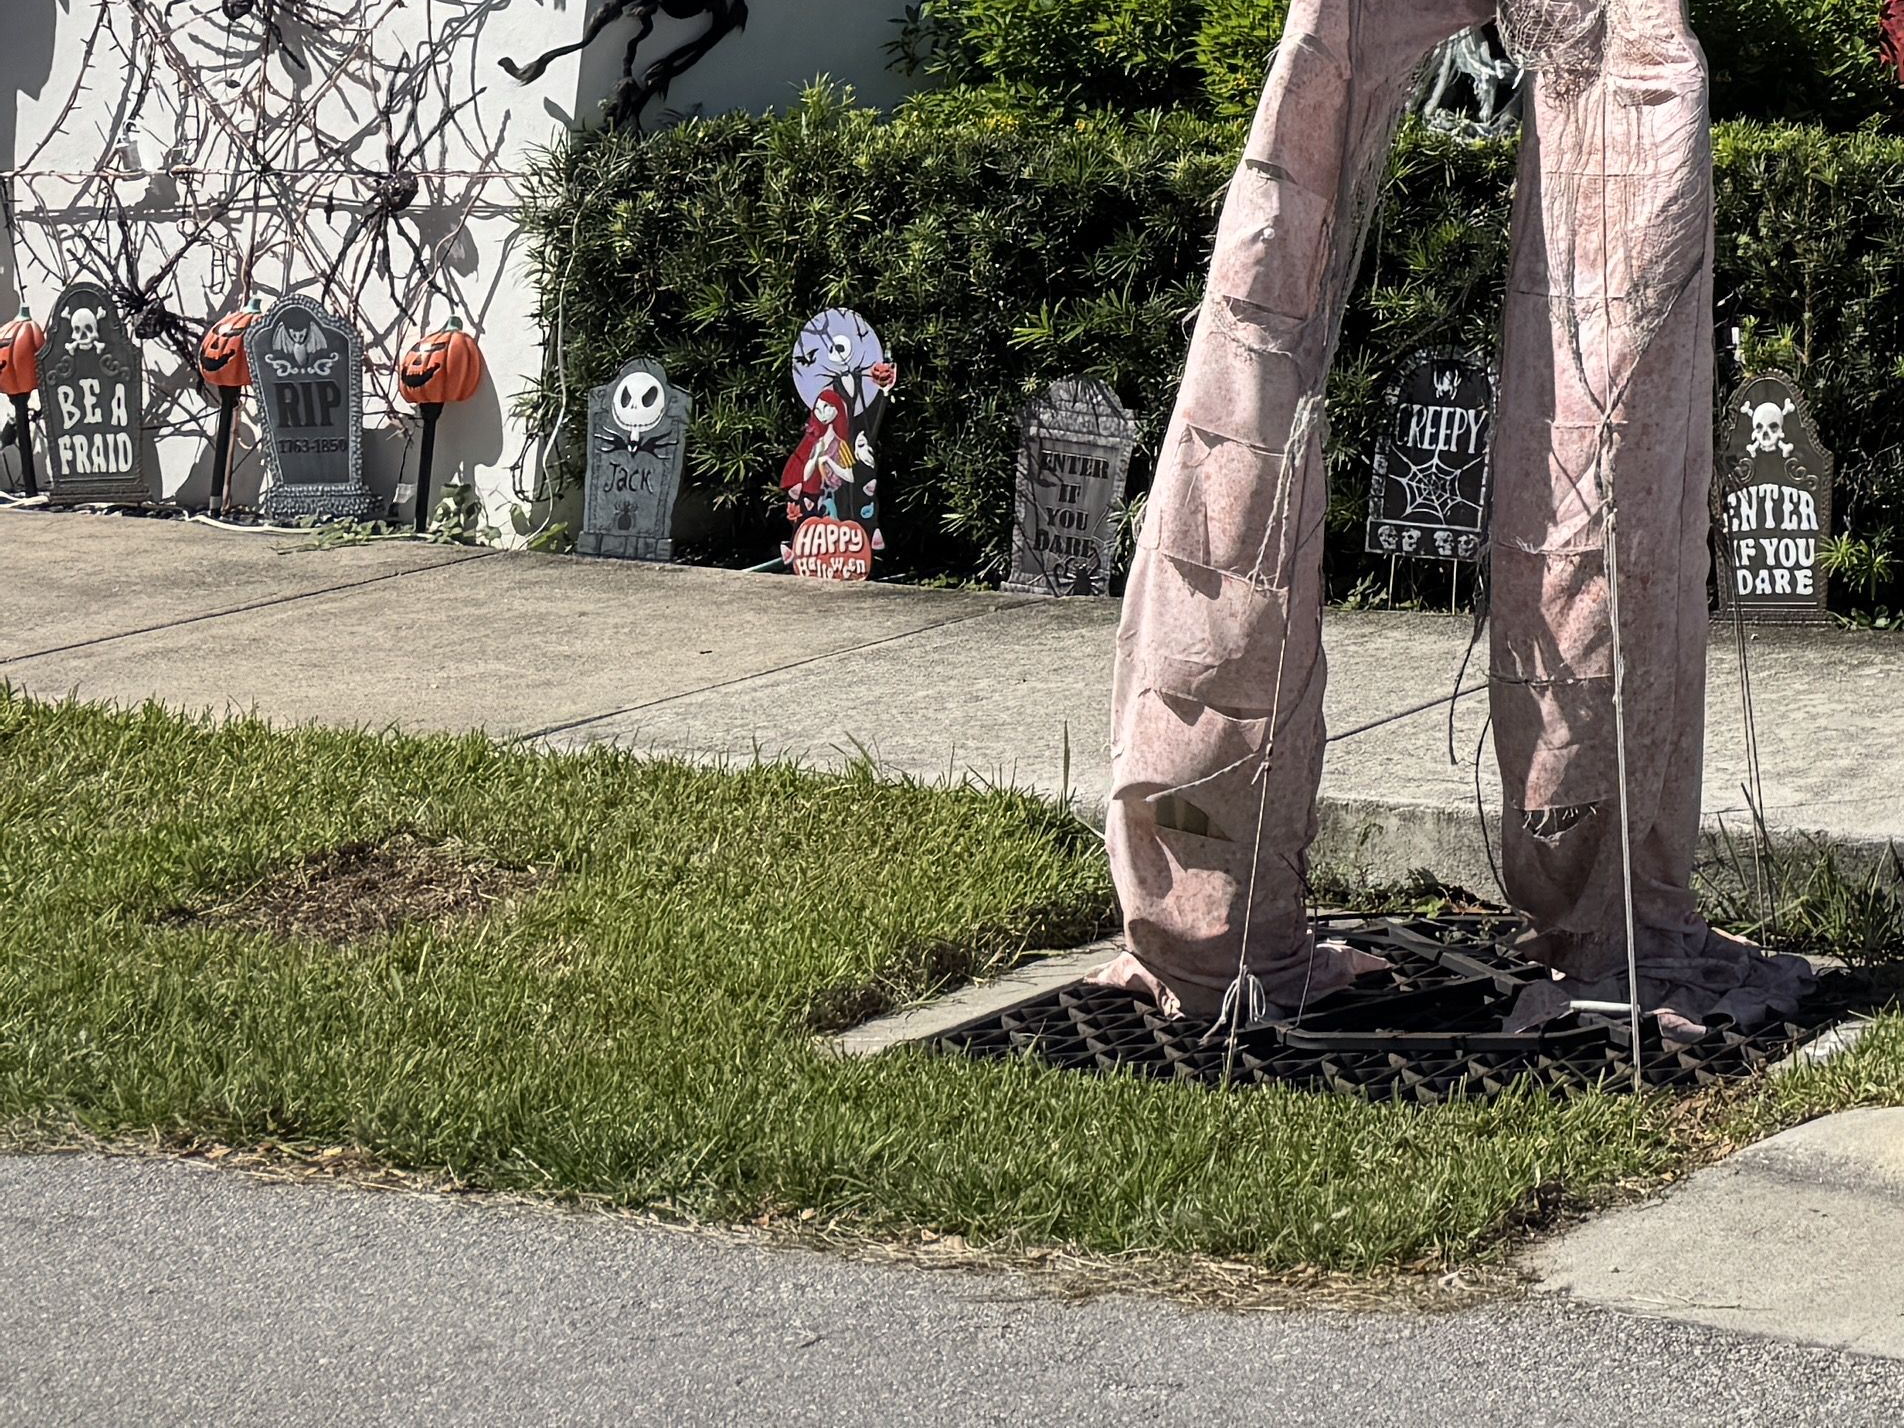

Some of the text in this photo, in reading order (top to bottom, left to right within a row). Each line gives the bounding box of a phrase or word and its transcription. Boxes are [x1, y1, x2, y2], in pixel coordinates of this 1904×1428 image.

[57, 378, 128, 429] BE A
[273, 380, 342, 428] RIP
[1396, 403, 1488, 454] CREEPY
[58, 432, 132, 475] FRAID
[279, 438, 349, 454] 1763-1850
[1040, 450, 1110, 479] ENTER
[1059, 484, 1081, 504] IF
[1722, 483, 1819, 533] ENTER
[1046, 506, 1088, 531] YOU
[1033, 528, 1097, 558] DARE
[1759, 538, 1815, 567] YOU
[1737, 568, 1814, 596] DARE
